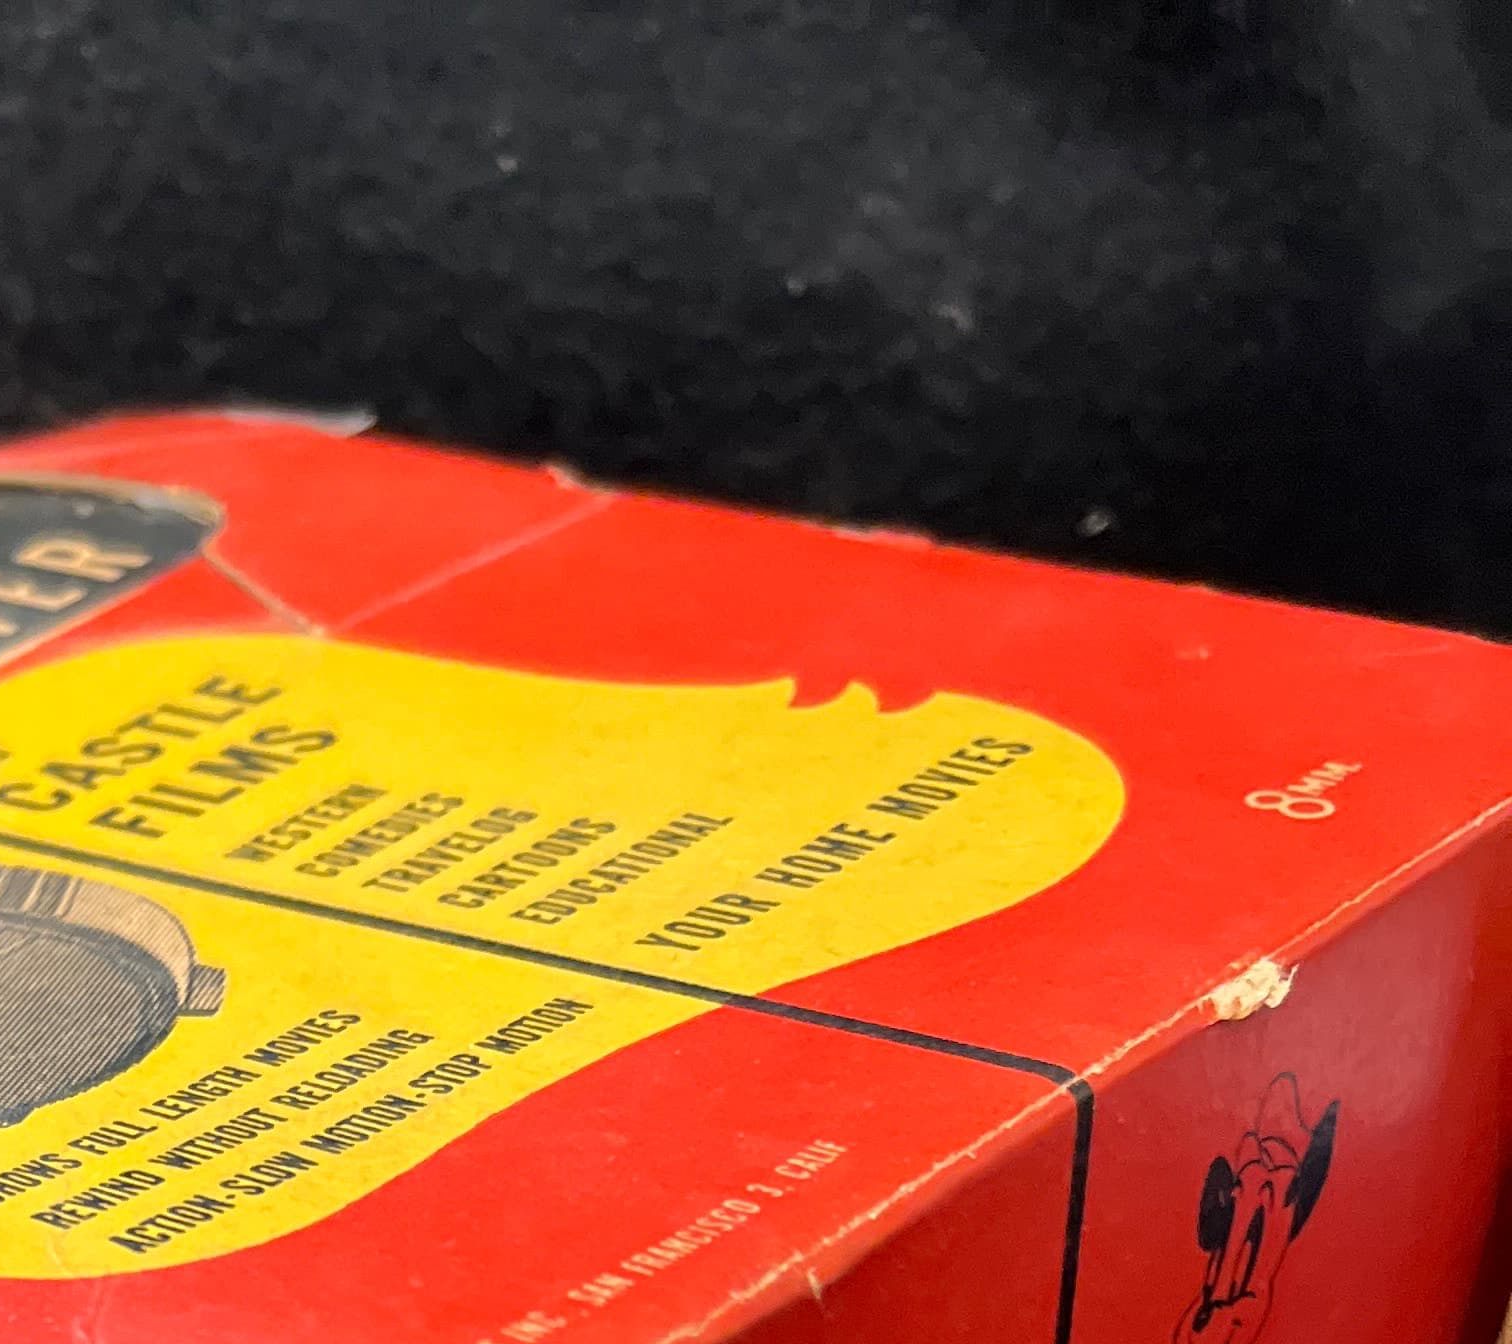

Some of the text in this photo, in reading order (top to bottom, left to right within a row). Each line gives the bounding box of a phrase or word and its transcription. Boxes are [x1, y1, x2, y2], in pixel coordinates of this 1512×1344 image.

[89, 723, 339, 839] FILMS
[224, 781, 389, 861] WESTERN
[295, 790, 465, 878] COMEDIES
[361, 806, 538, 894] TRAVELOG
[436, 816, 617, 911] CARTOONS
[510, 810, 734, 925] EDUCATIONAL
[635, 734, 1035, 953] YOUR HOME MOVIES
[30, 1026, 436, 1231] REWIND WITHOUT RELOADING
[70, 1120, 159, 1156] FULL
[154, 1066, 262, 1121] LENGTH
[242, 1008, 361, 1068] MOVIES
[108, 996, 595, 1255] ACTION-SLOW MOTION-STOP MOTION
[567, 1272, 635, 1308] SAN
[619, 1198, 760, 1277] FRANCISCO
[774, 1139, 847, 1180] CALIF
